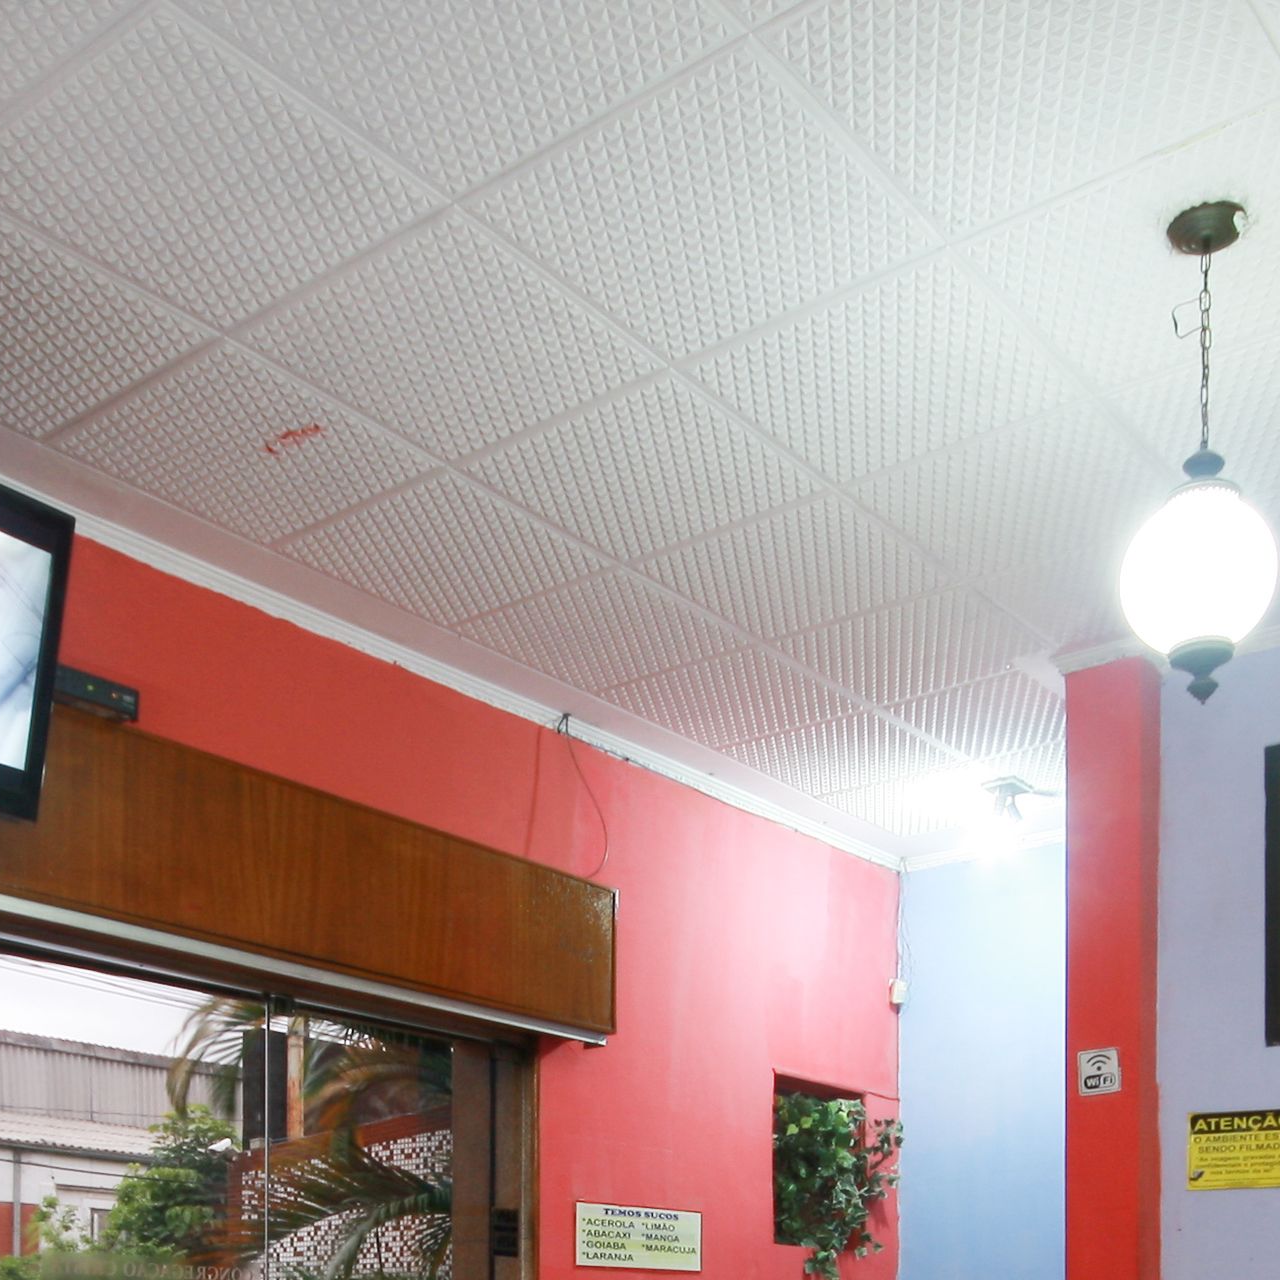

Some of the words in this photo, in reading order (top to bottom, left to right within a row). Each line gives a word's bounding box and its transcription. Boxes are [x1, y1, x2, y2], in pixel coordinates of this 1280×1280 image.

[1205, 1133, 1259, 1144] AMBIENTE
[1198, 1145, 1236, 1154] SENDO
[603, 1208, 641, 1217] TEMOS
[644, 1211, 679, 1221] SUCOS
